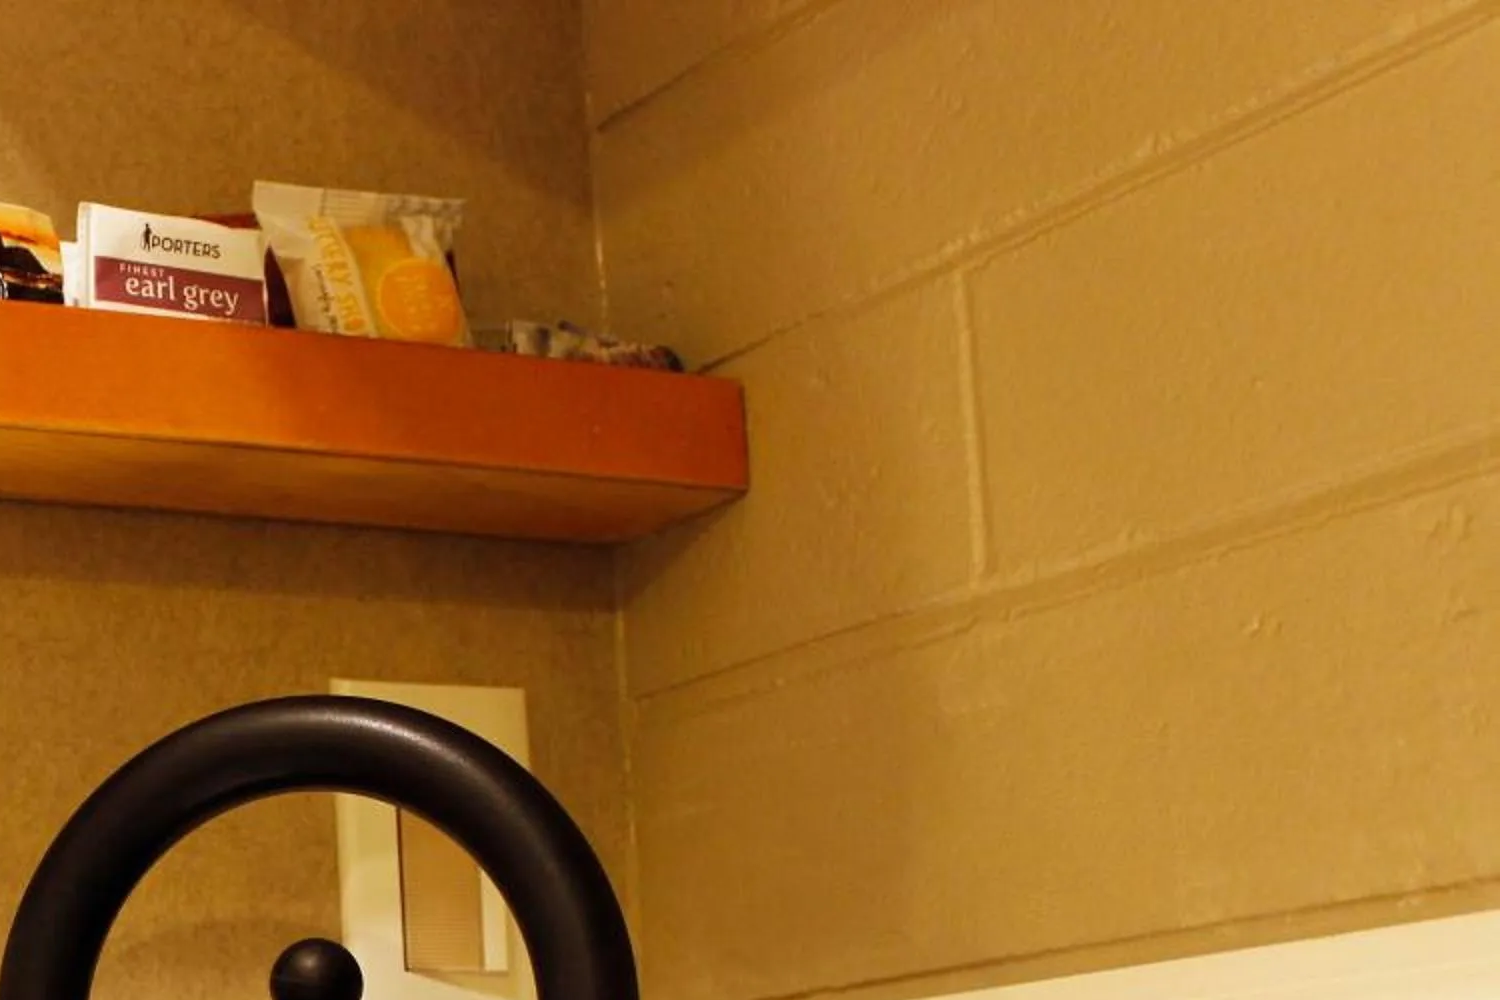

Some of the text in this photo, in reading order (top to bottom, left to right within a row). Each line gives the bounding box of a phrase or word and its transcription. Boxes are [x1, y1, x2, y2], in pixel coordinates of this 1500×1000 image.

[151, 235, 221, 259] PORTERS
[125, 275, 240, 316] earl grey
